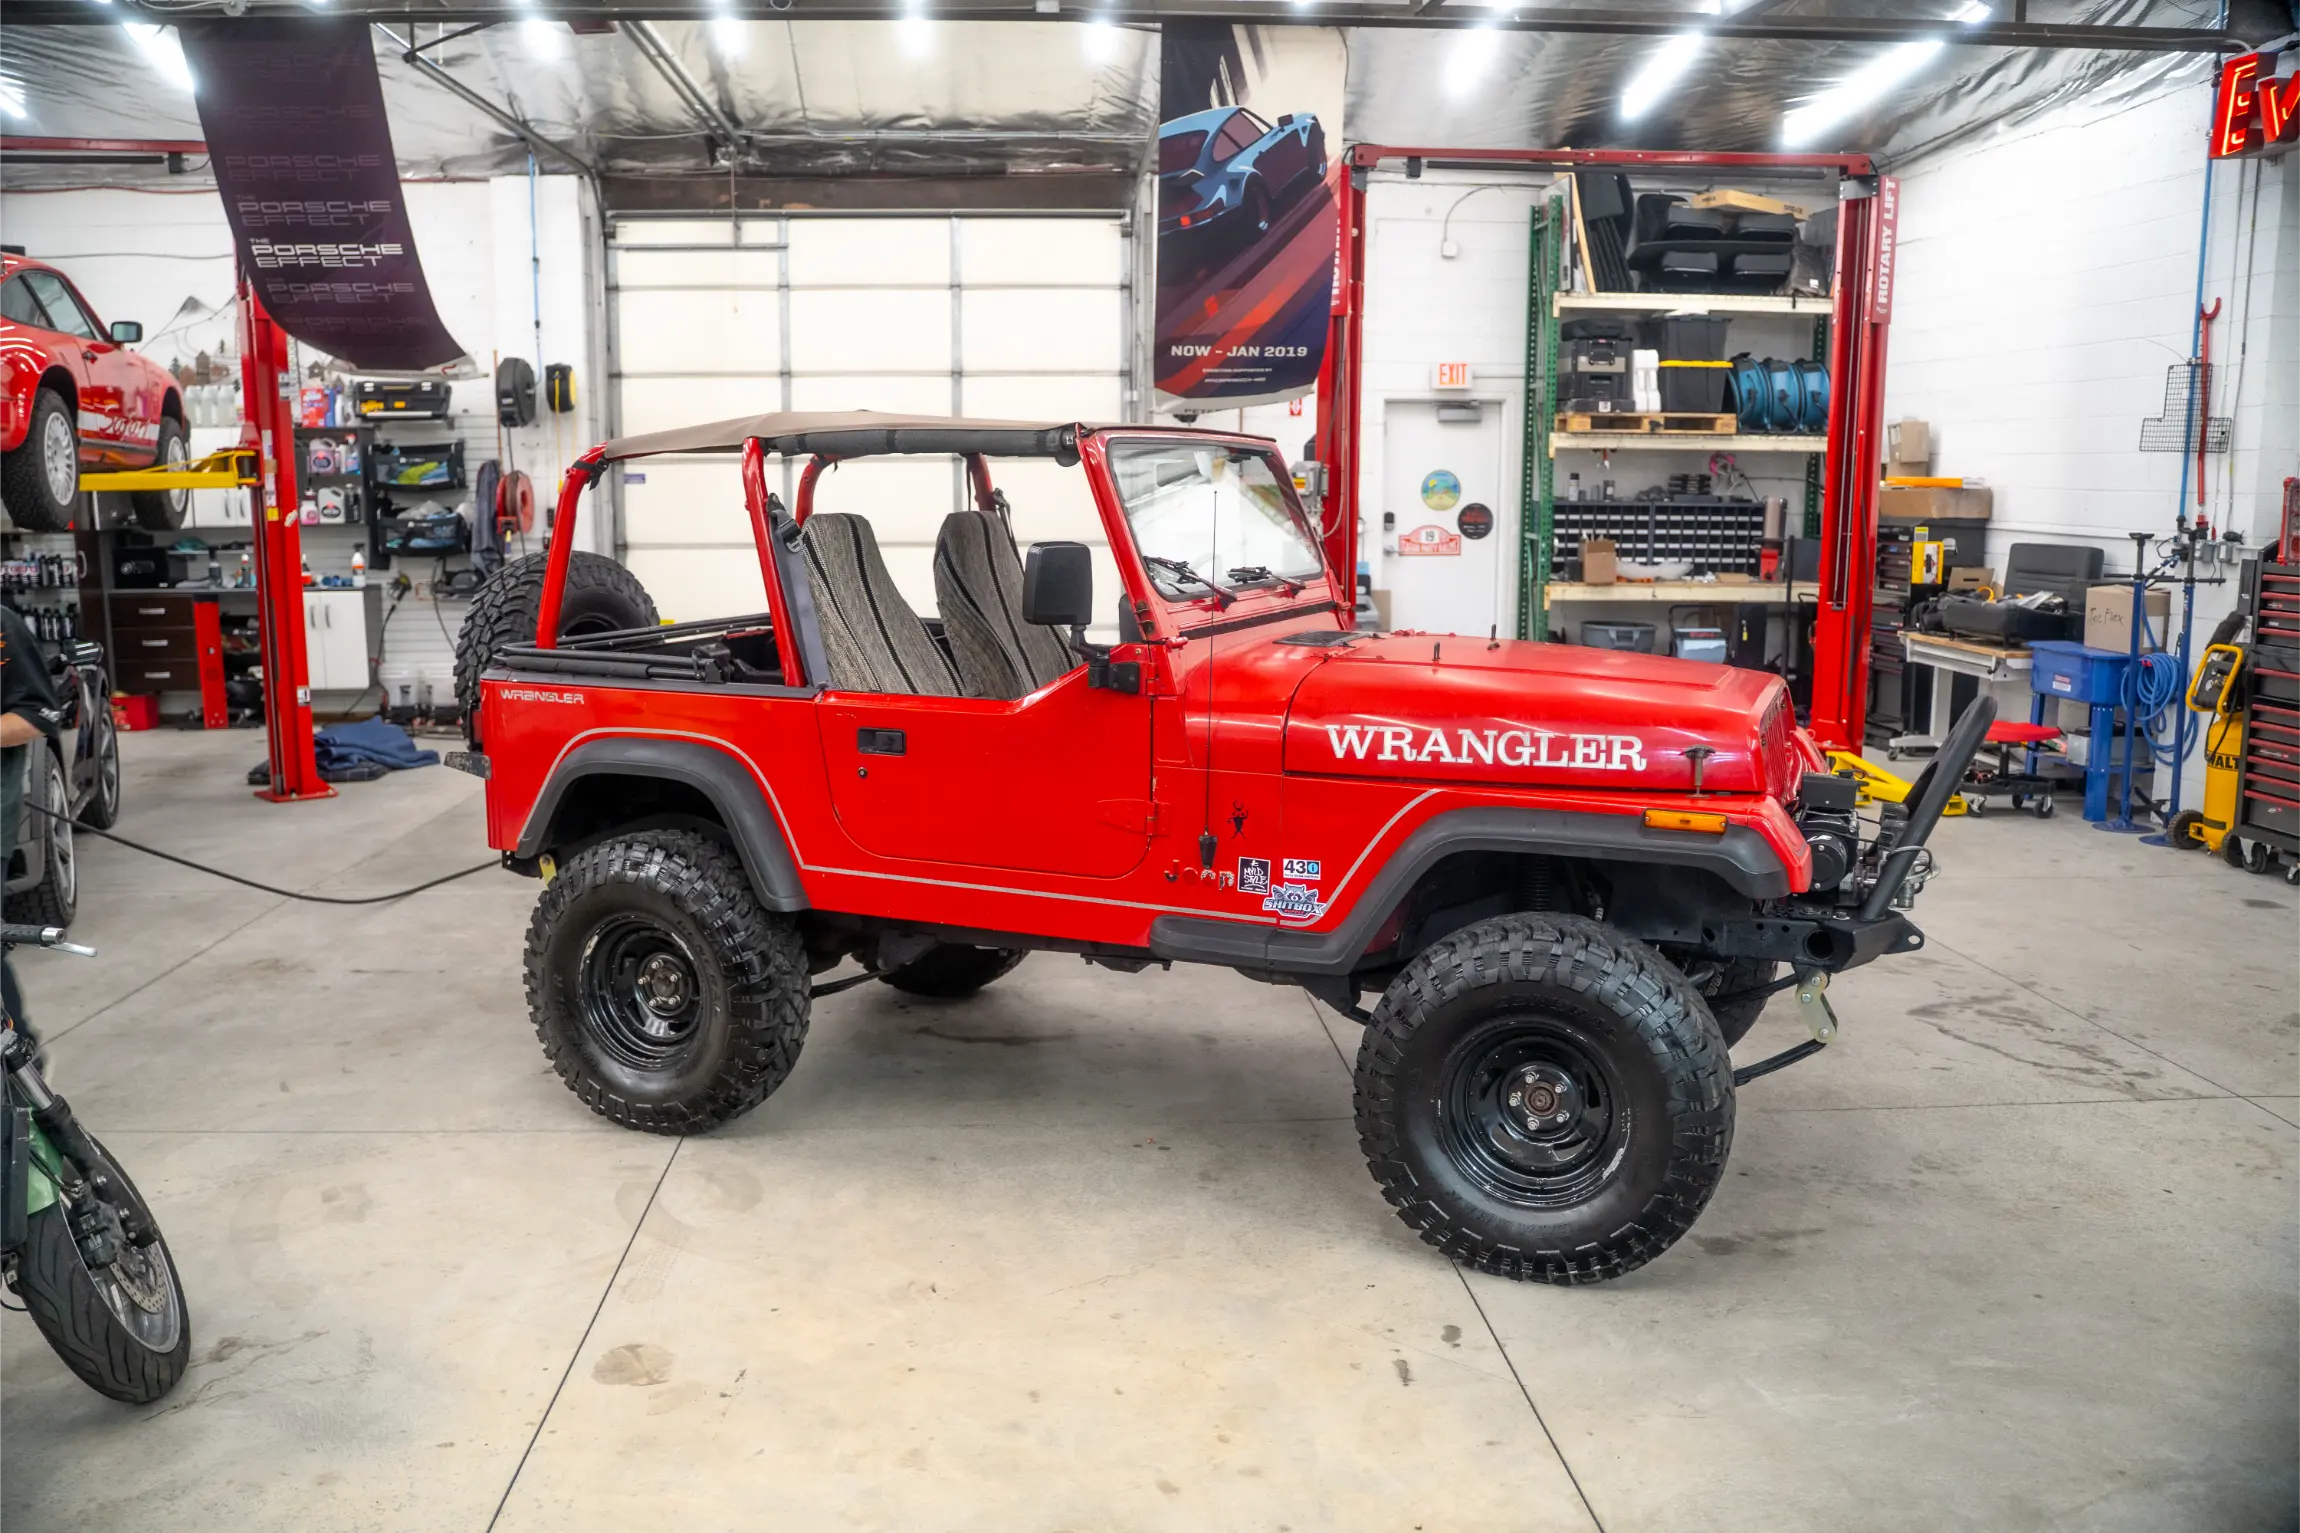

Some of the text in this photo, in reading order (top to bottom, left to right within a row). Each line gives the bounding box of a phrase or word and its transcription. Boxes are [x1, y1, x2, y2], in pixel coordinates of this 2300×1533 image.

[225, 154, 382, 168] PORSCHE
[228, 168, 361, 182] EFFECT
[237, 201, 392, 214] PORSCHE
[241, 214, 371, 227] EFFECT
[1877, 178, 1896, 304] ROTARY LIFT
[251, 243, 404, 256] PORSCHE
[255, 255, 383, 268] EFFECT
[266, 282, 416, 294] PORSCHE
[271, 292, 395, 304] EFFECT
[1170, 345, 1212, 357] NOW
[1226, 346, 1260, 357] JAN
[1264, 346, 1308, 357] 2019
[1439, 364, 1468, 386] EXIT
[500, 689, 585, 704] WRANGLER
[1325, 725, 1647, 771] WRANGLER
[1244, 874, 1268, 885] STYLE
[1264, 899, 1324, 914] SHITBOX
